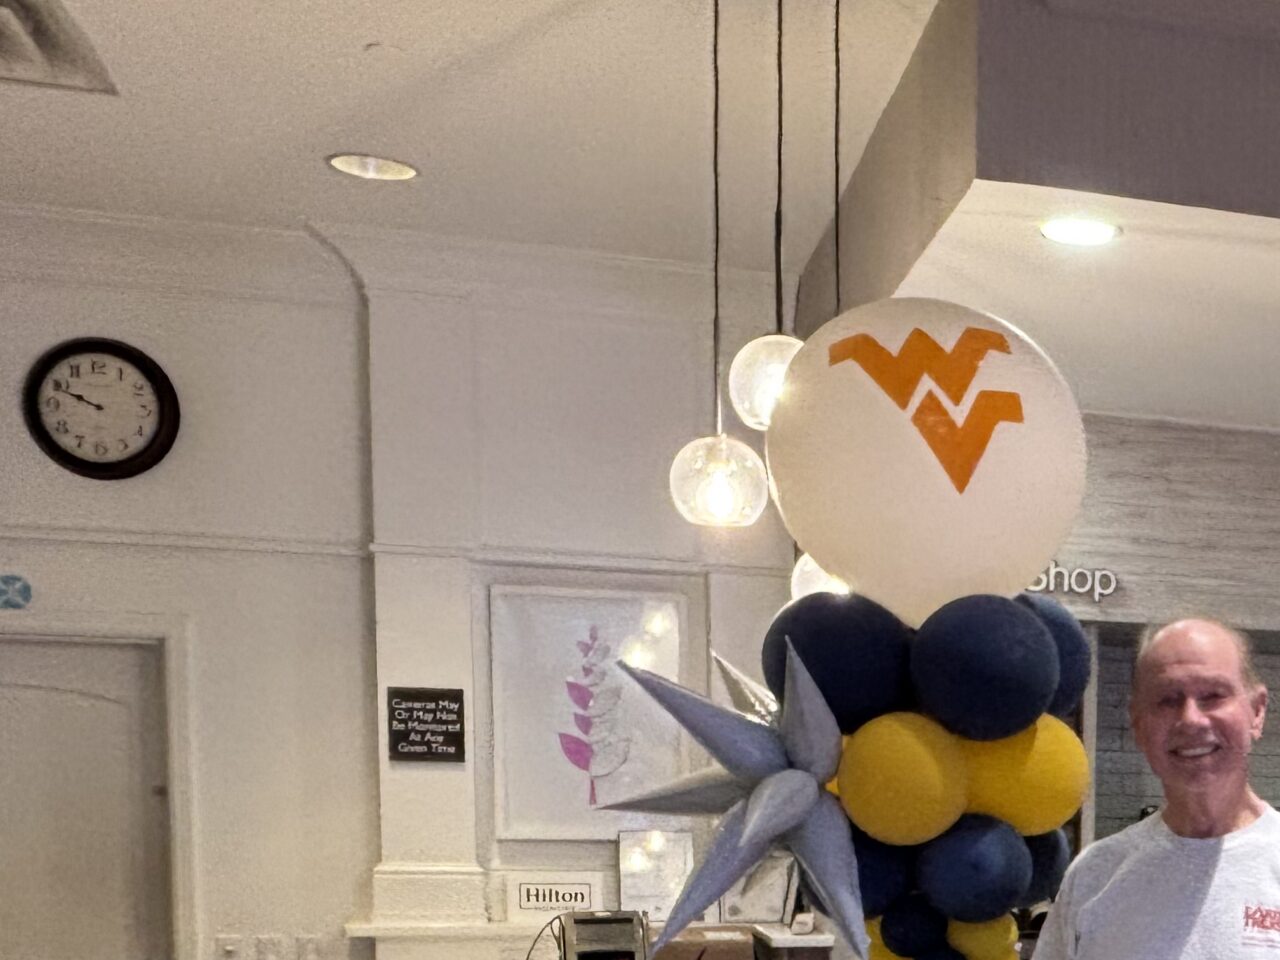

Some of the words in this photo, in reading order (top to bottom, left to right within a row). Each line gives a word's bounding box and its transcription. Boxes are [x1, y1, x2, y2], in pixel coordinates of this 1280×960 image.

[438, 700, 460, 712] May
[413, 710, 434, 722] May
[526, 887, 585, 903] Hilton
